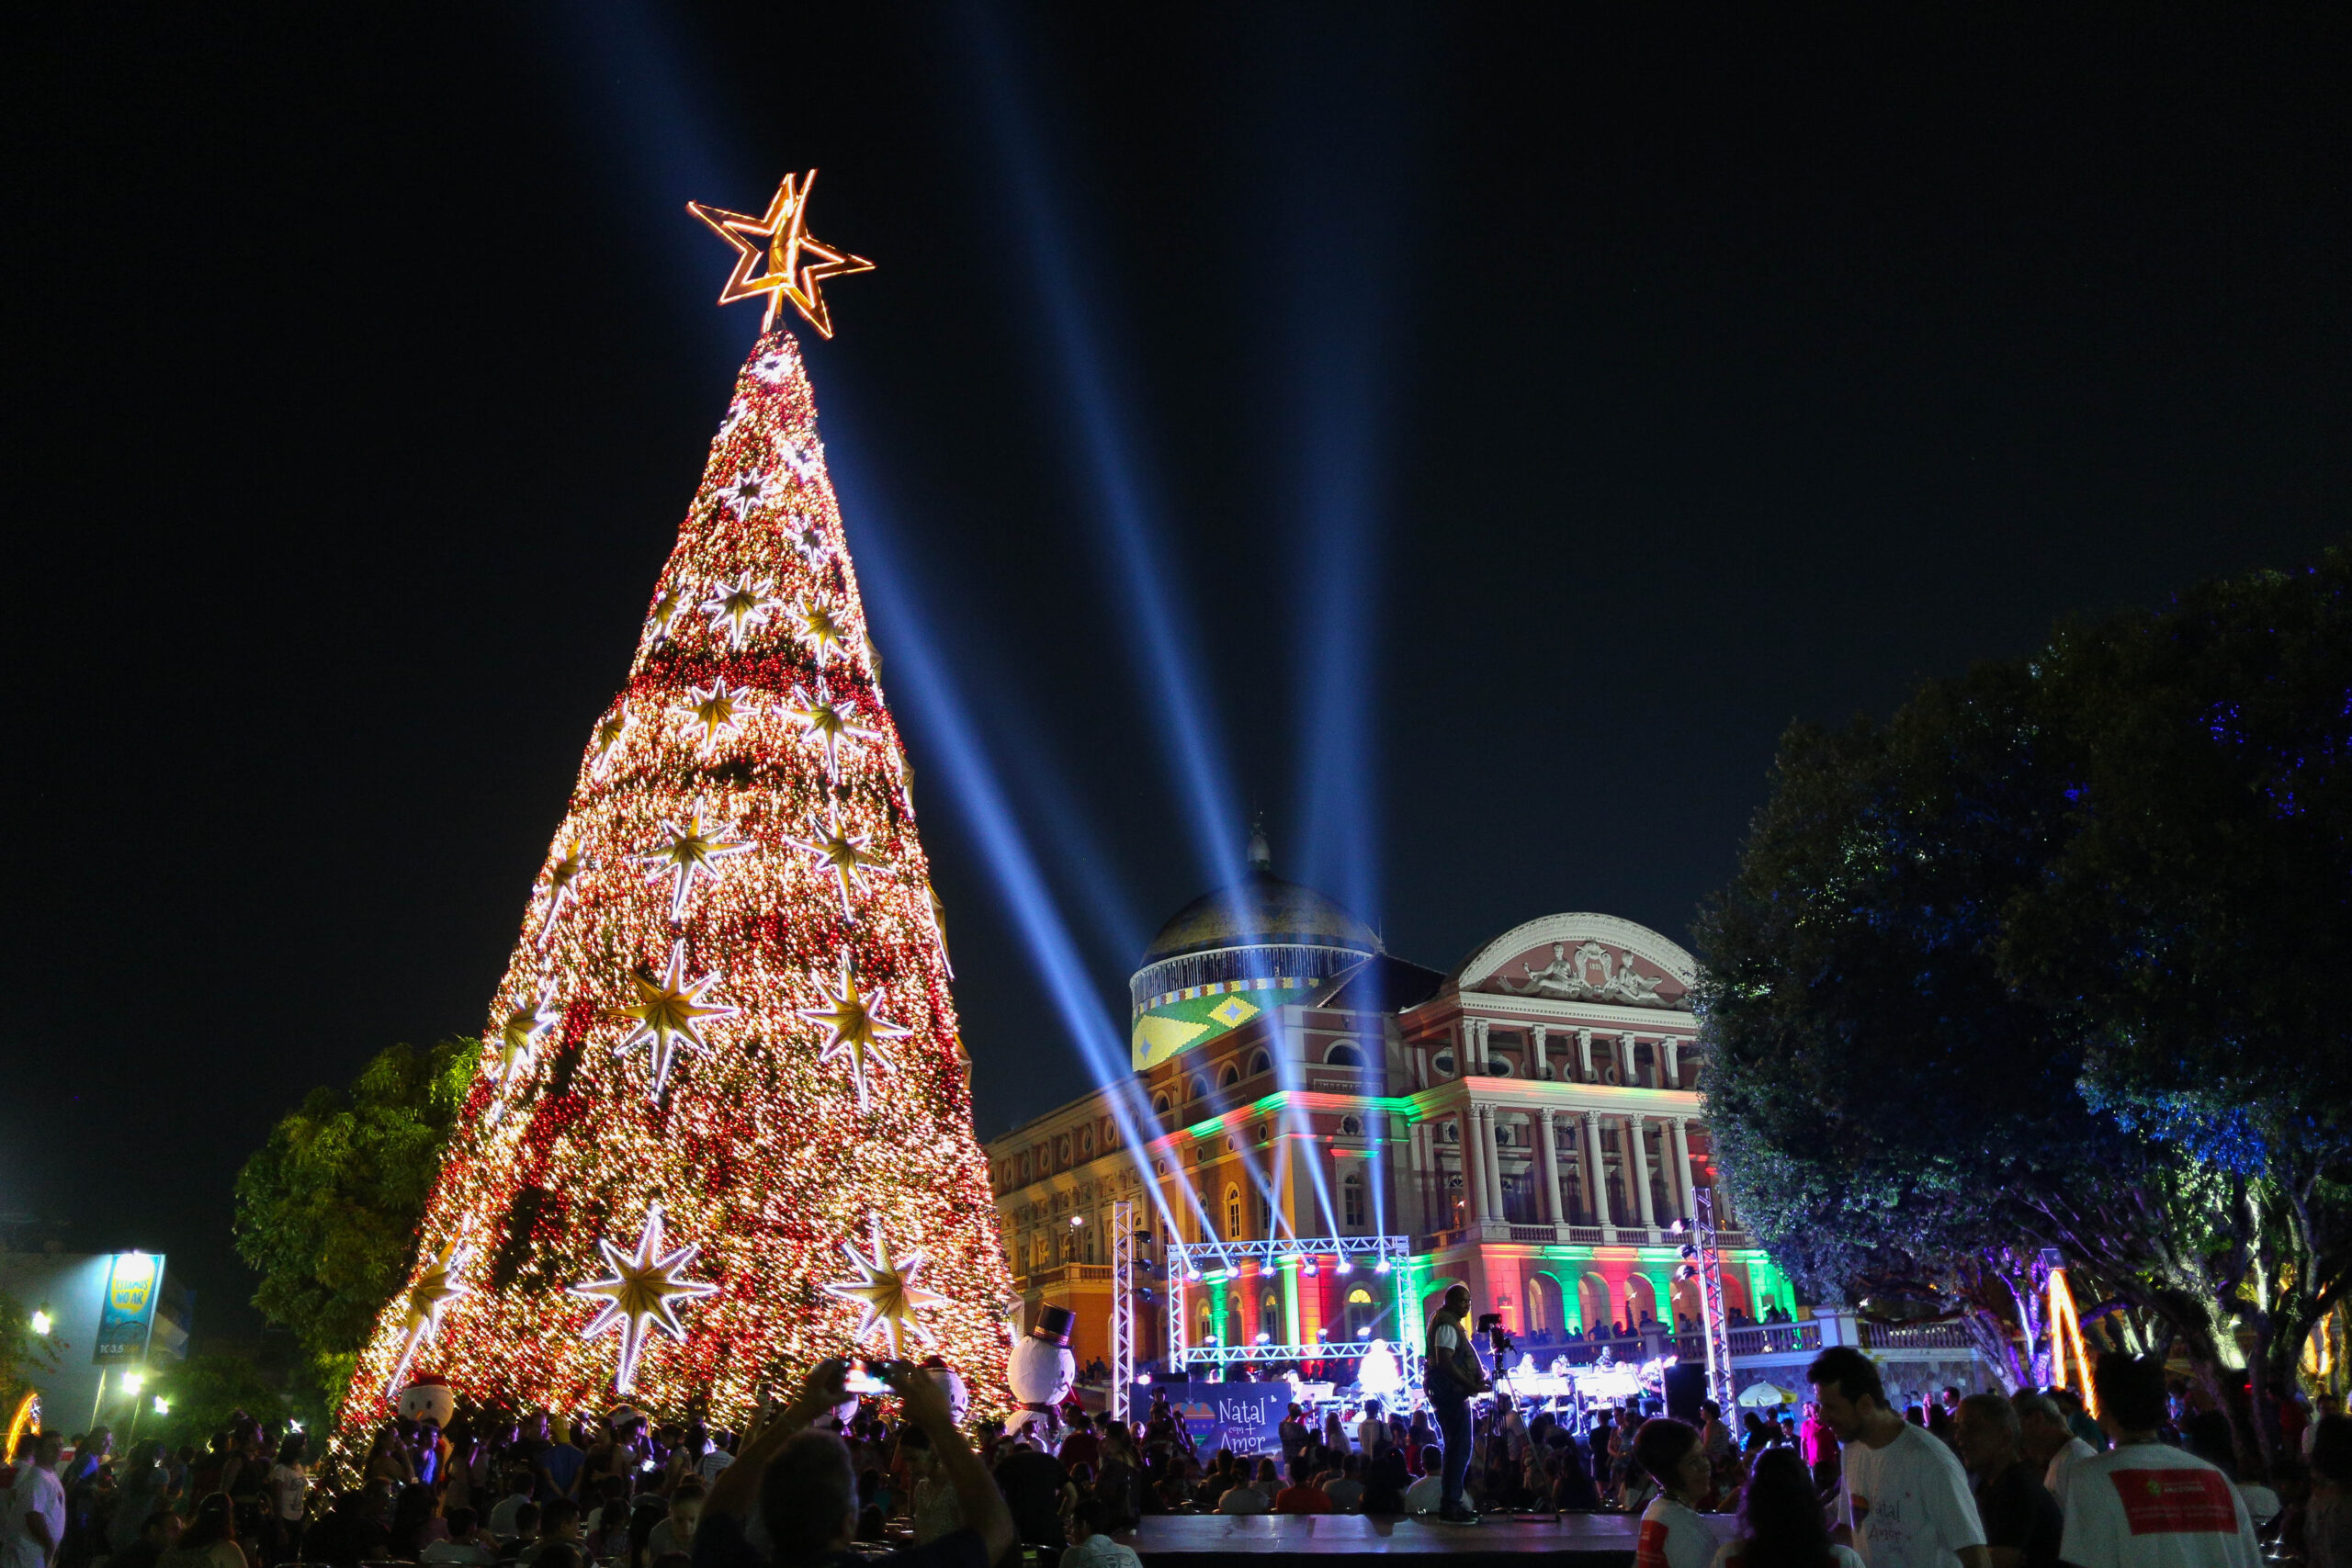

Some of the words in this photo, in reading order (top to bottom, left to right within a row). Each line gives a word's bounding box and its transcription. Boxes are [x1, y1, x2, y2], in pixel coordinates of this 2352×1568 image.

[116, 1292, 130, 1304] NO
[130, 1291, 144, 1305] AR
[1219, 1397, 1266, 1426] Natal
[1228, 1427, 1244, 1435] com
[1221, 1432, 1266, 1453] Amor
